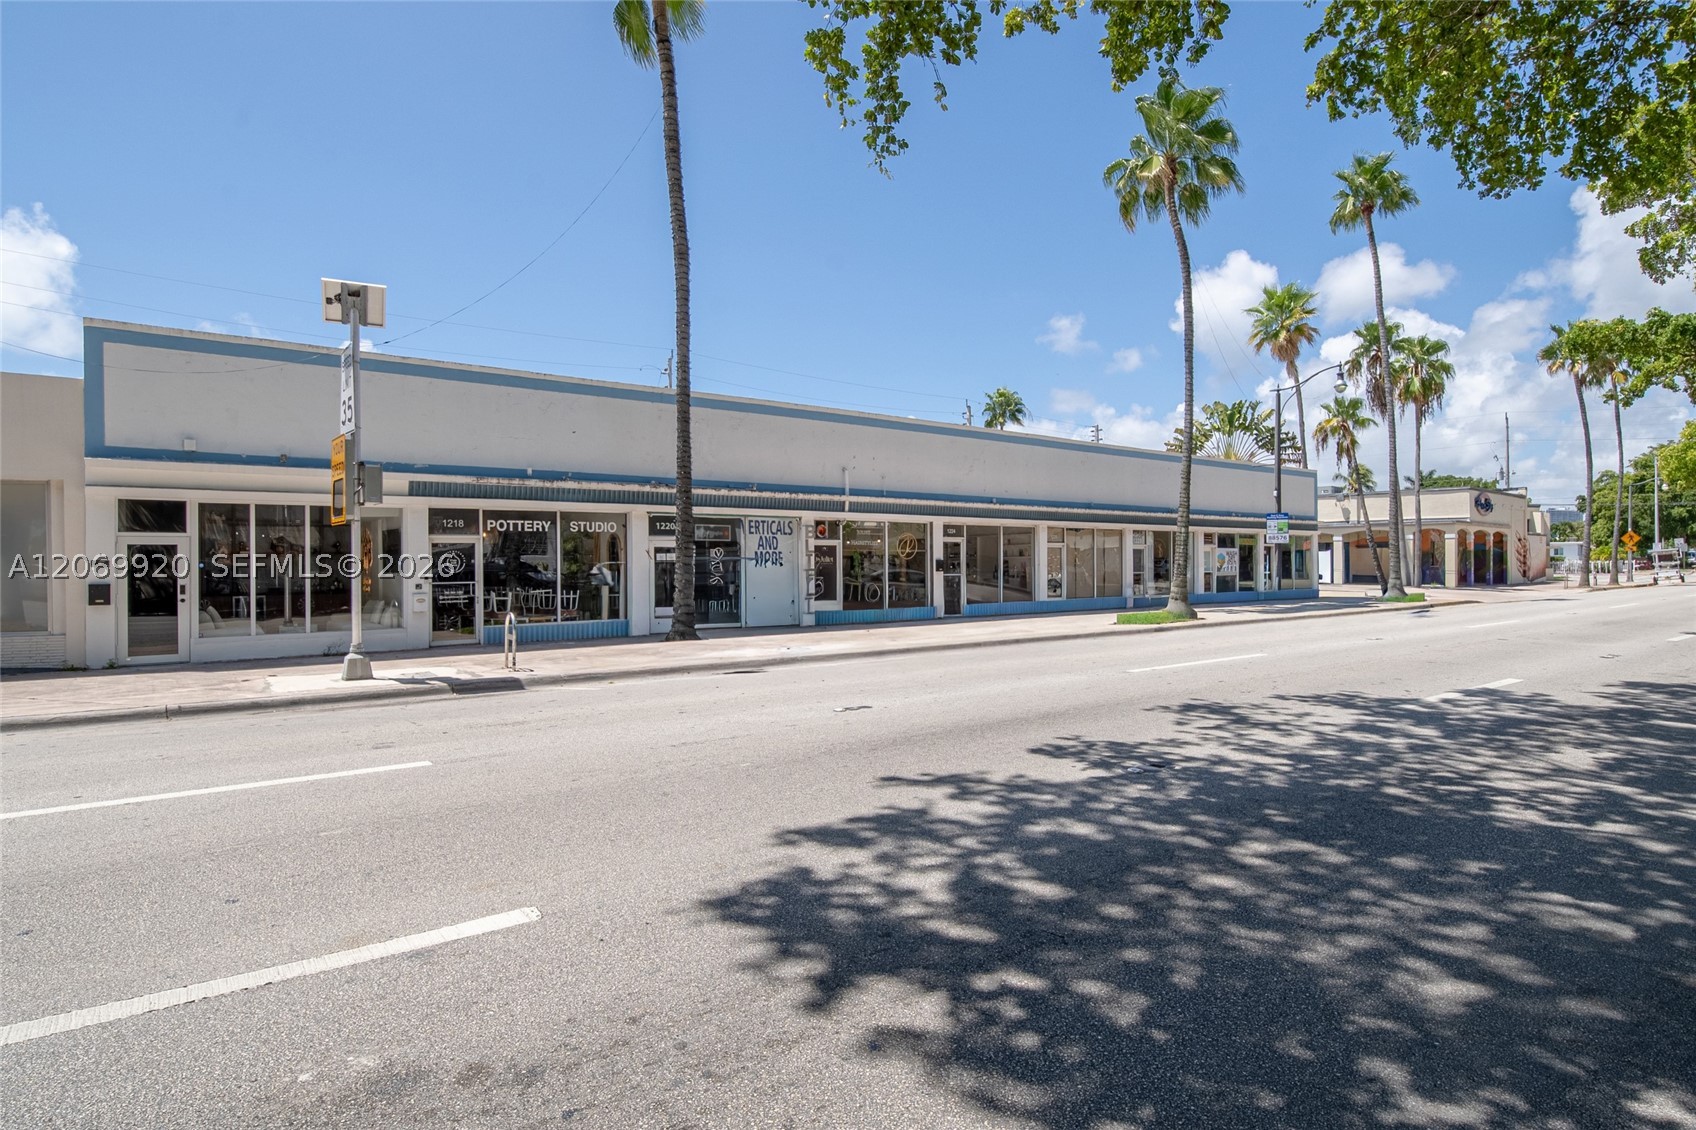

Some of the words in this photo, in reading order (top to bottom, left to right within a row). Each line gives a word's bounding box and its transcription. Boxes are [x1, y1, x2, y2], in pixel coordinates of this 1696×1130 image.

[342, 396, 352, 426] 35
[442, 519, 465, 528] 1218
[486, 519, 551, 532] POTTERY
[569, 521, 617, 533] STUDIO
[655, 522, 676, 530] 1220
[757, 535, 779, 550] AND
